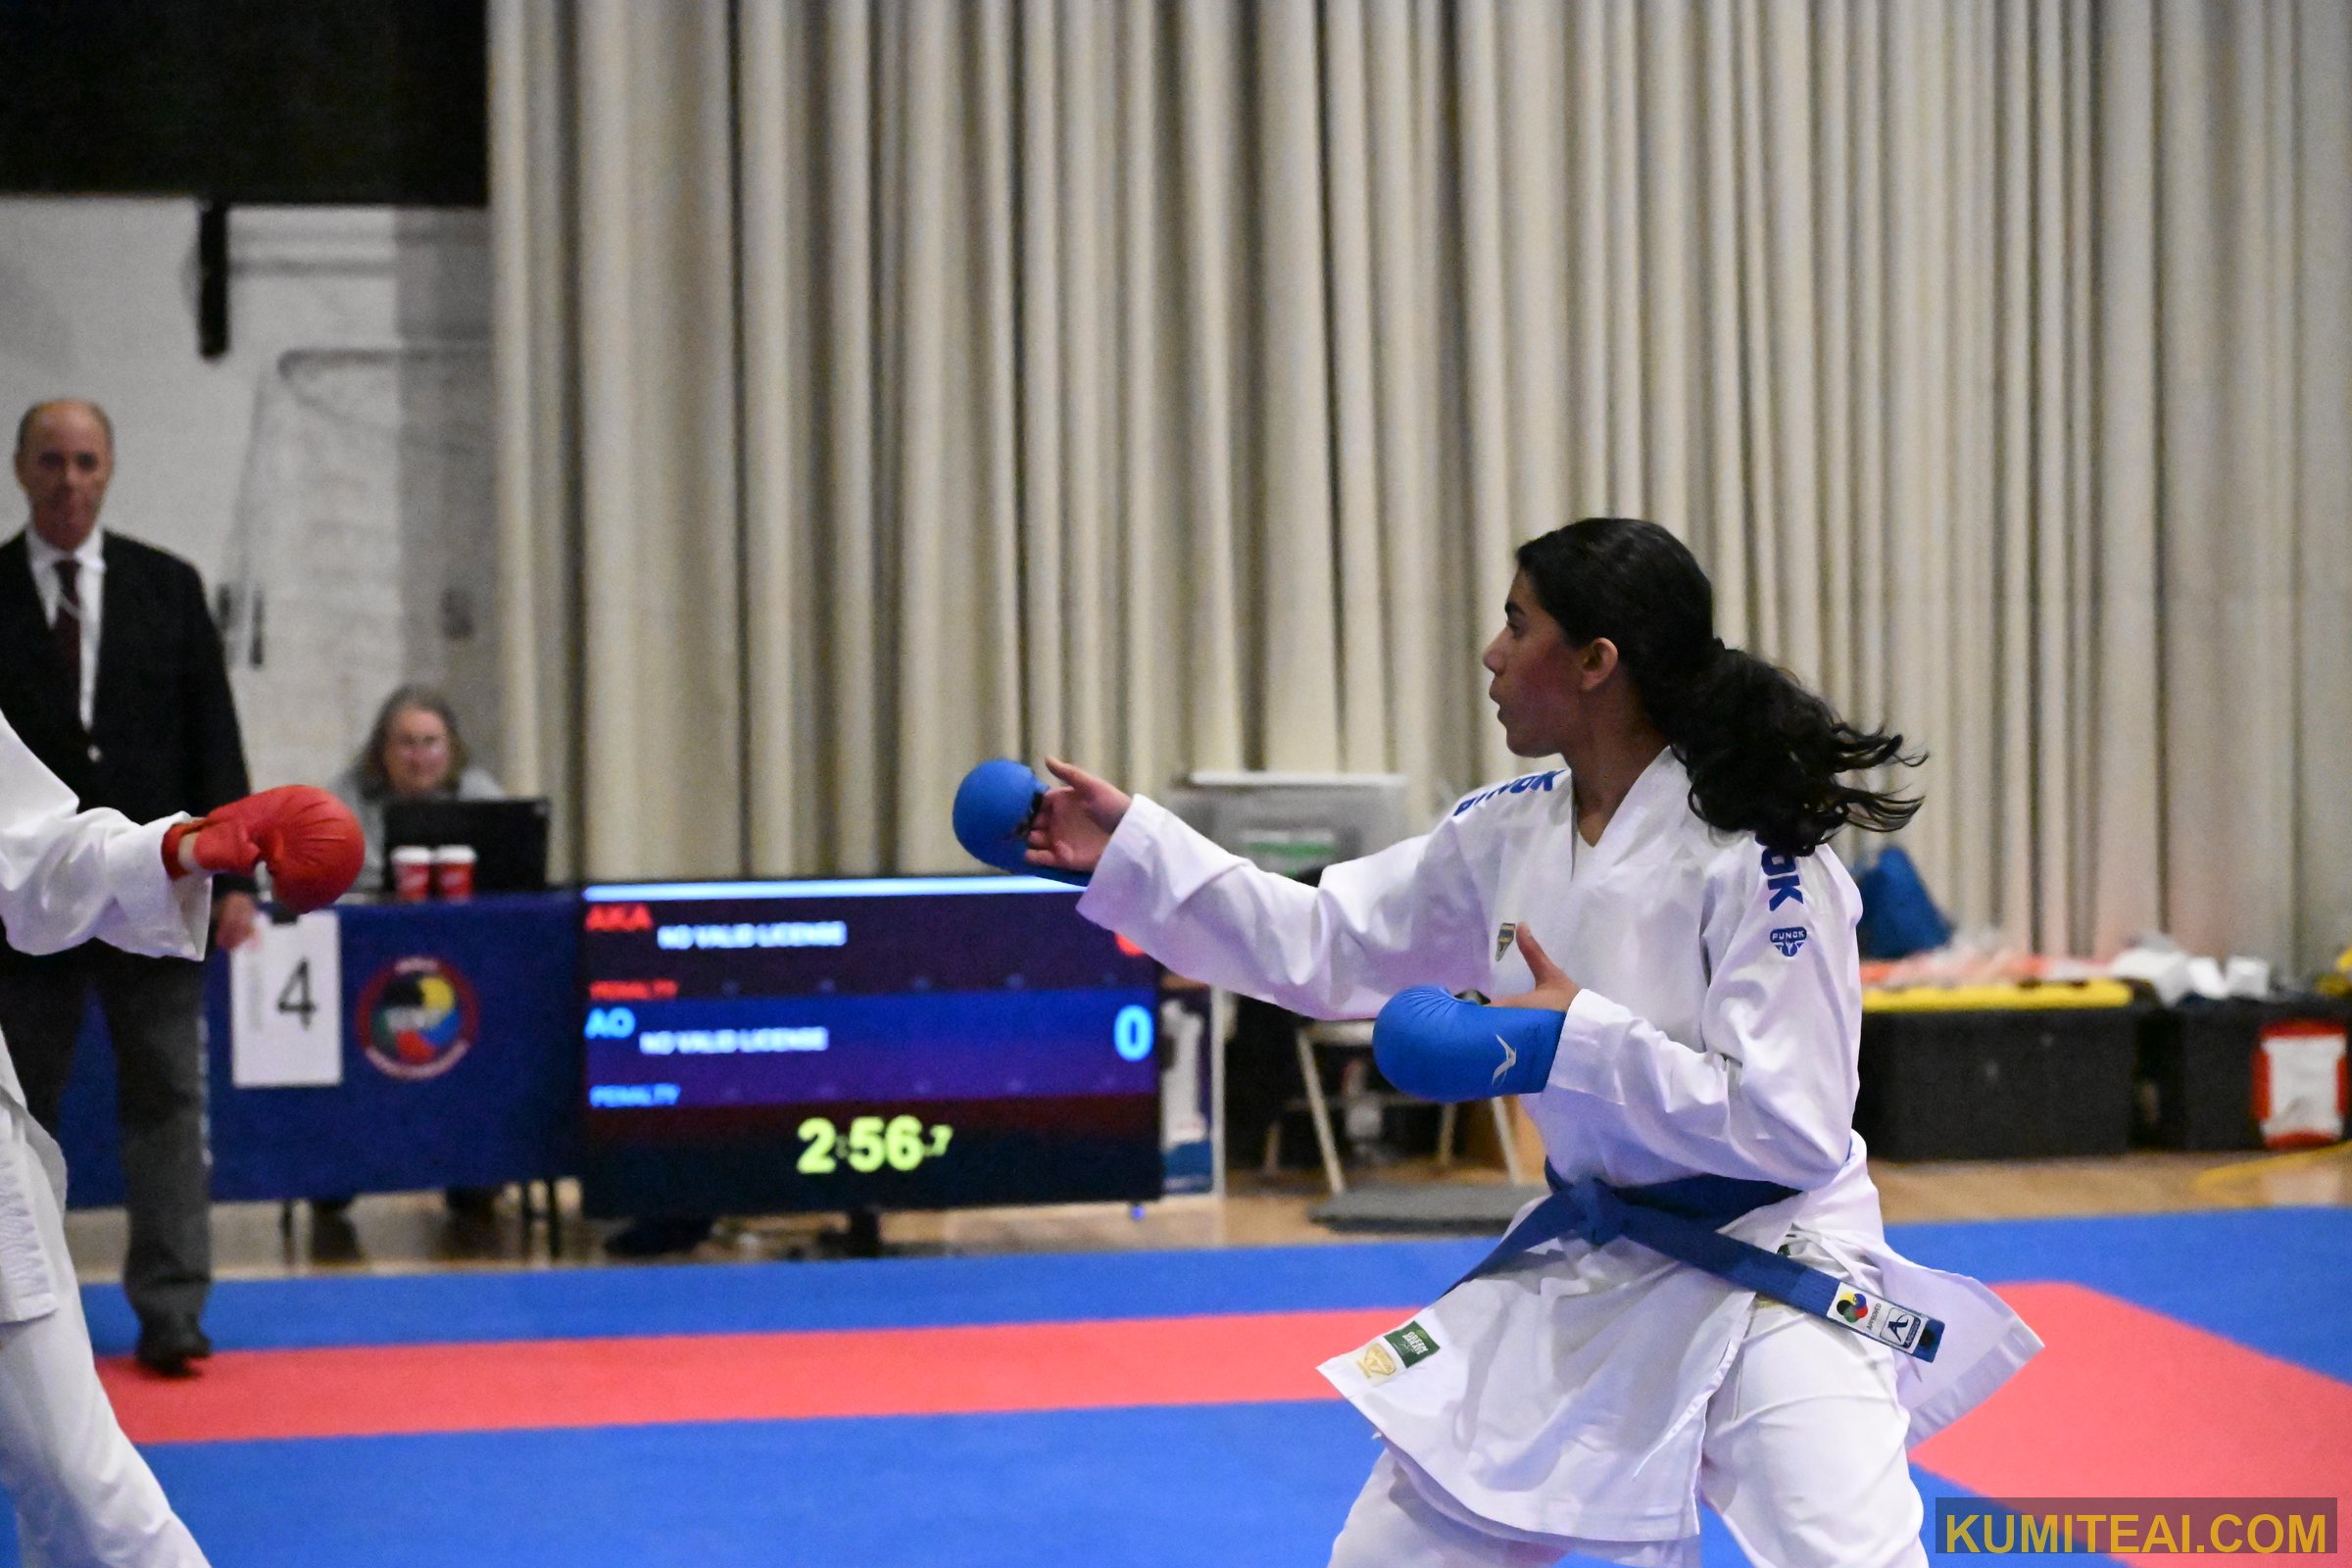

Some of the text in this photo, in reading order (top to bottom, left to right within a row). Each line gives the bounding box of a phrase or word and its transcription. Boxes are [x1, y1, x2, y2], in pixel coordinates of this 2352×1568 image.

[585, 902, 654, 931] AKA
[277, 957, 316, 1031] 4
[585, 1006, 635, 1039] AO
[1113, 1004, 1153, 1061] 0
